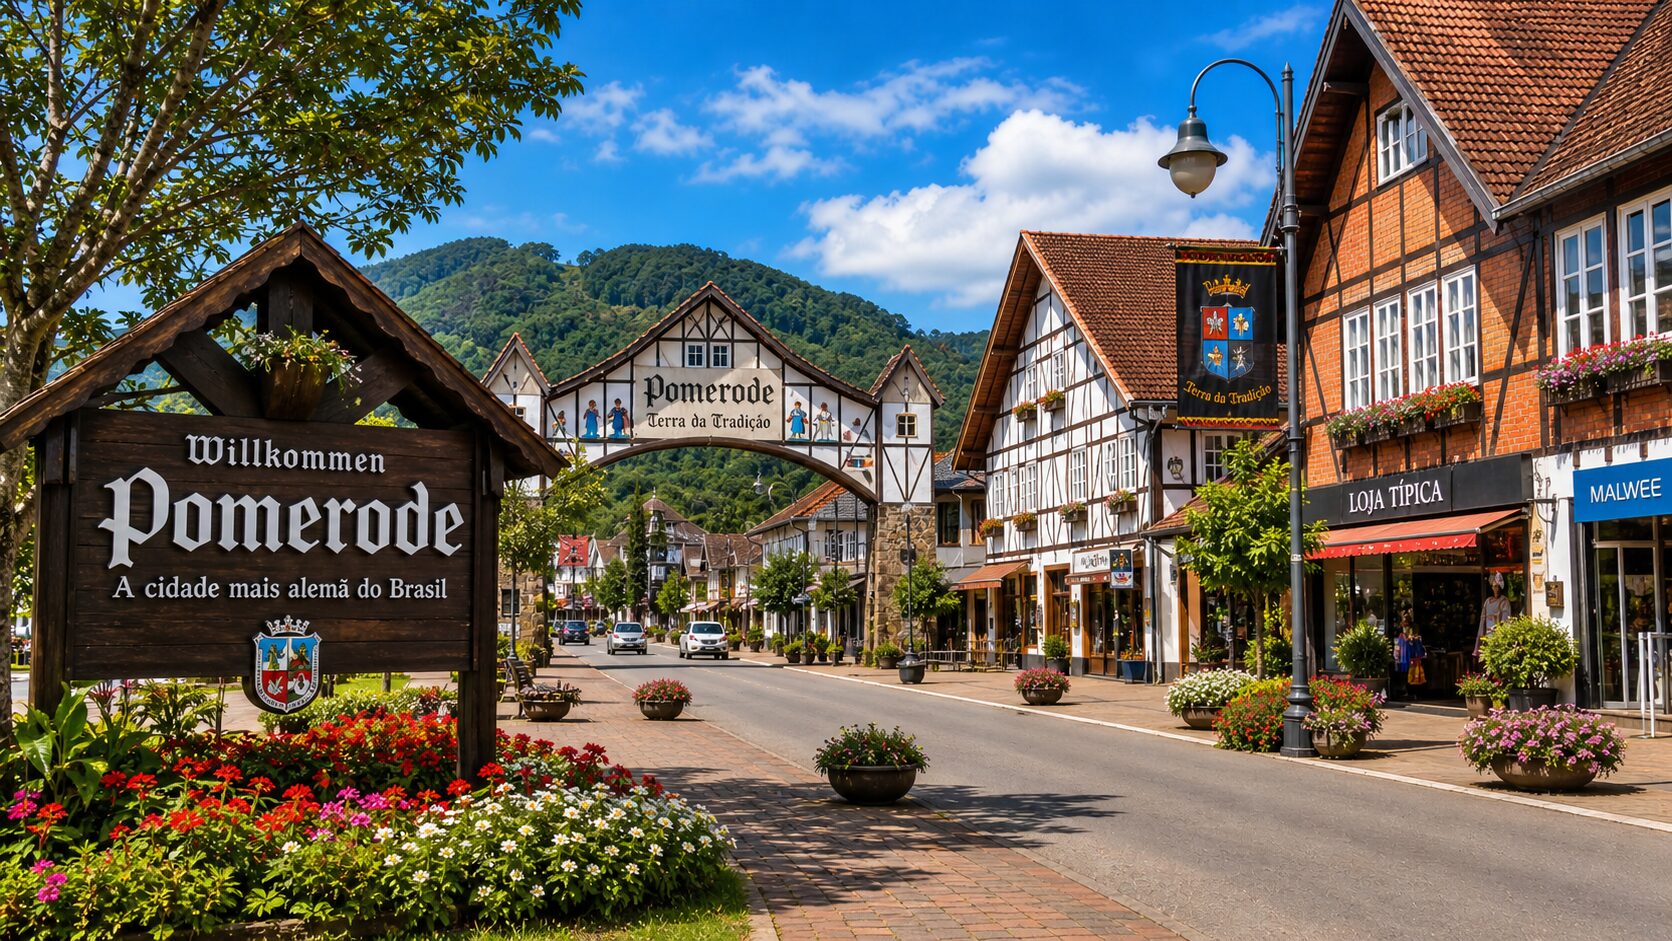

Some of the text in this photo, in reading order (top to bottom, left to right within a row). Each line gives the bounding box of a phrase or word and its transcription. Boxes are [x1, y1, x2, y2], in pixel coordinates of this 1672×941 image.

[644, 374, 774, 408] Pomerode
[646, 412, 685, 428] Terra
[691, 413, 706, 428] da
[185, 434, 385, 474] Willkommen
[1349, 478, 1444, 515] LOJA TÍPICA
[1590, 477, 1662, 503] MALWEE
[98, 467, 465, 569] Pomerode
[112, 576, 448, 599] A cidade mais alemã do Brasil
